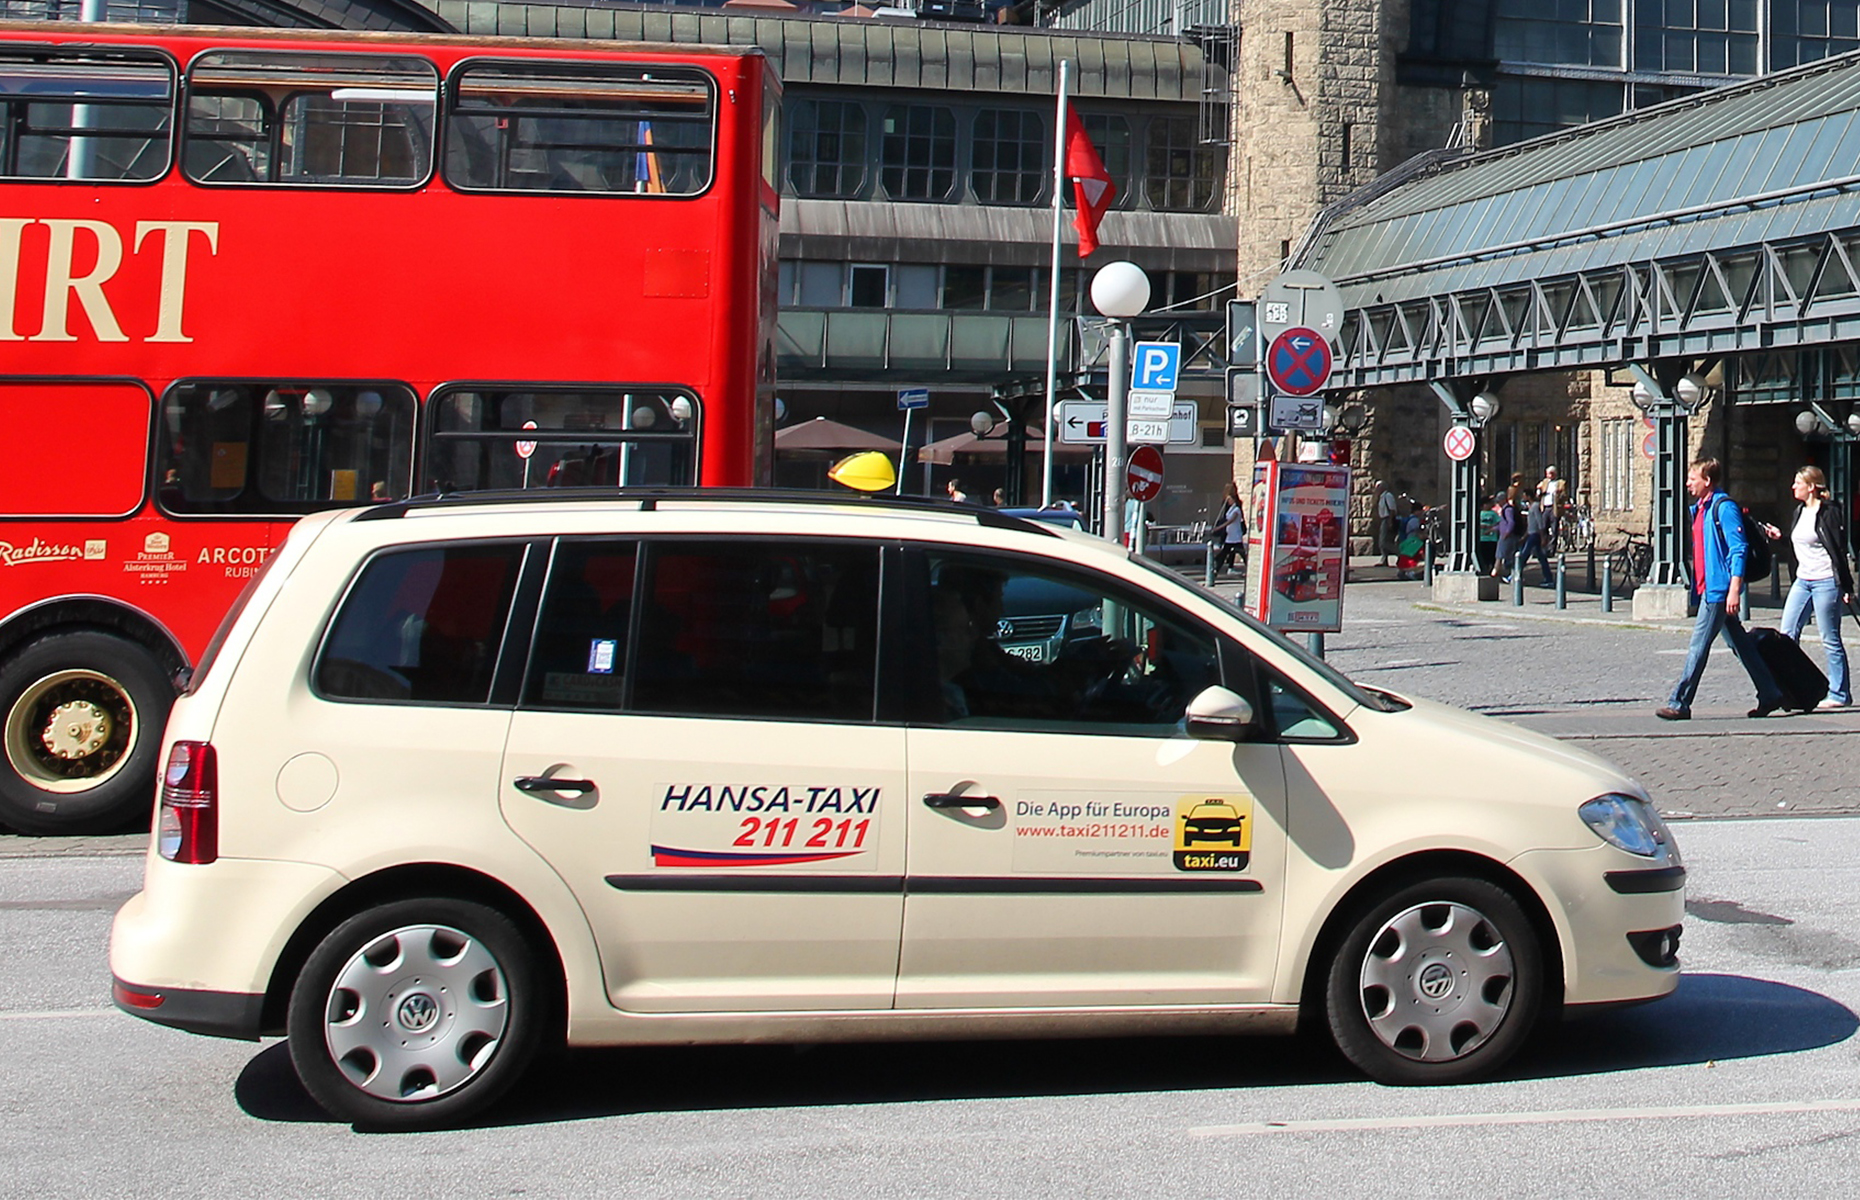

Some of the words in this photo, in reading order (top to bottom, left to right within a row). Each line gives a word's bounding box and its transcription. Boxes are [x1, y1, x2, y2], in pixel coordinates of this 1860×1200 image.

[1142, 349, 1169, 384] P
[1171, 409, 1192, 420] nhof
[0, 537, 83, 566] Radisson
[660, 784, 881, 814] HANSA-TAXI
[1016, 801, 1043, 817] Die
[1047, 802, 1081, 821] App
[1085, 801, 1109, 817] für
[1113, 803, 1170, 821] Europa
[732, 816, 799, 847] 211
[804, 817, 870, 848] 211
[1016, 824, 1169, 839] www.taxi211211.de
[1184, 853, 1238, 869] taxi.eu
